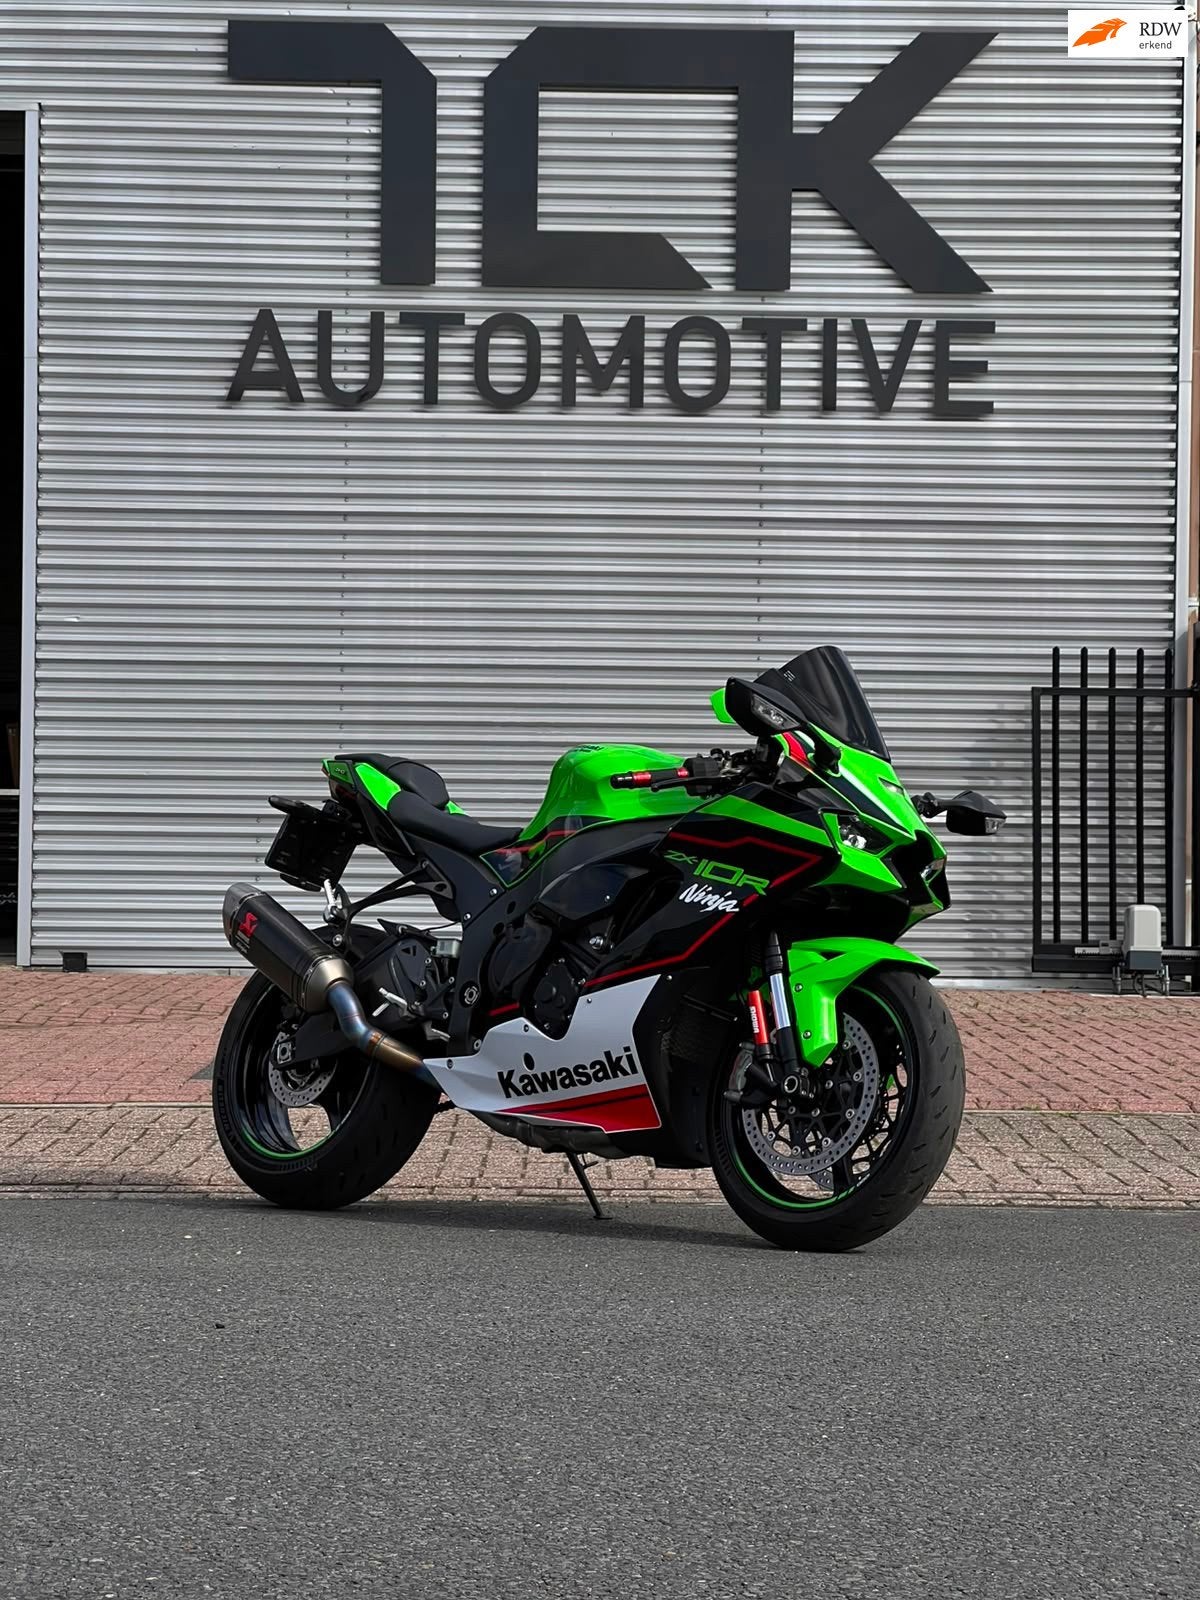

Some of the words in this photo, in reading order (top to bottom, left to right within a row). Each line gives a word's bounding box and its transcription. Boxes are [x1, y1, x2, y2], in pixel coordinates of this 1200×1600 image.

[227, 20, 1000, 293] TCK
[225, 308, 996, 416] AUTOMOTIVE
[664, 849, 770, 896] ZX-10R
[679, 883, 740, 913] Ninja
[497, 1046, 639, 1099] Kawasaki
